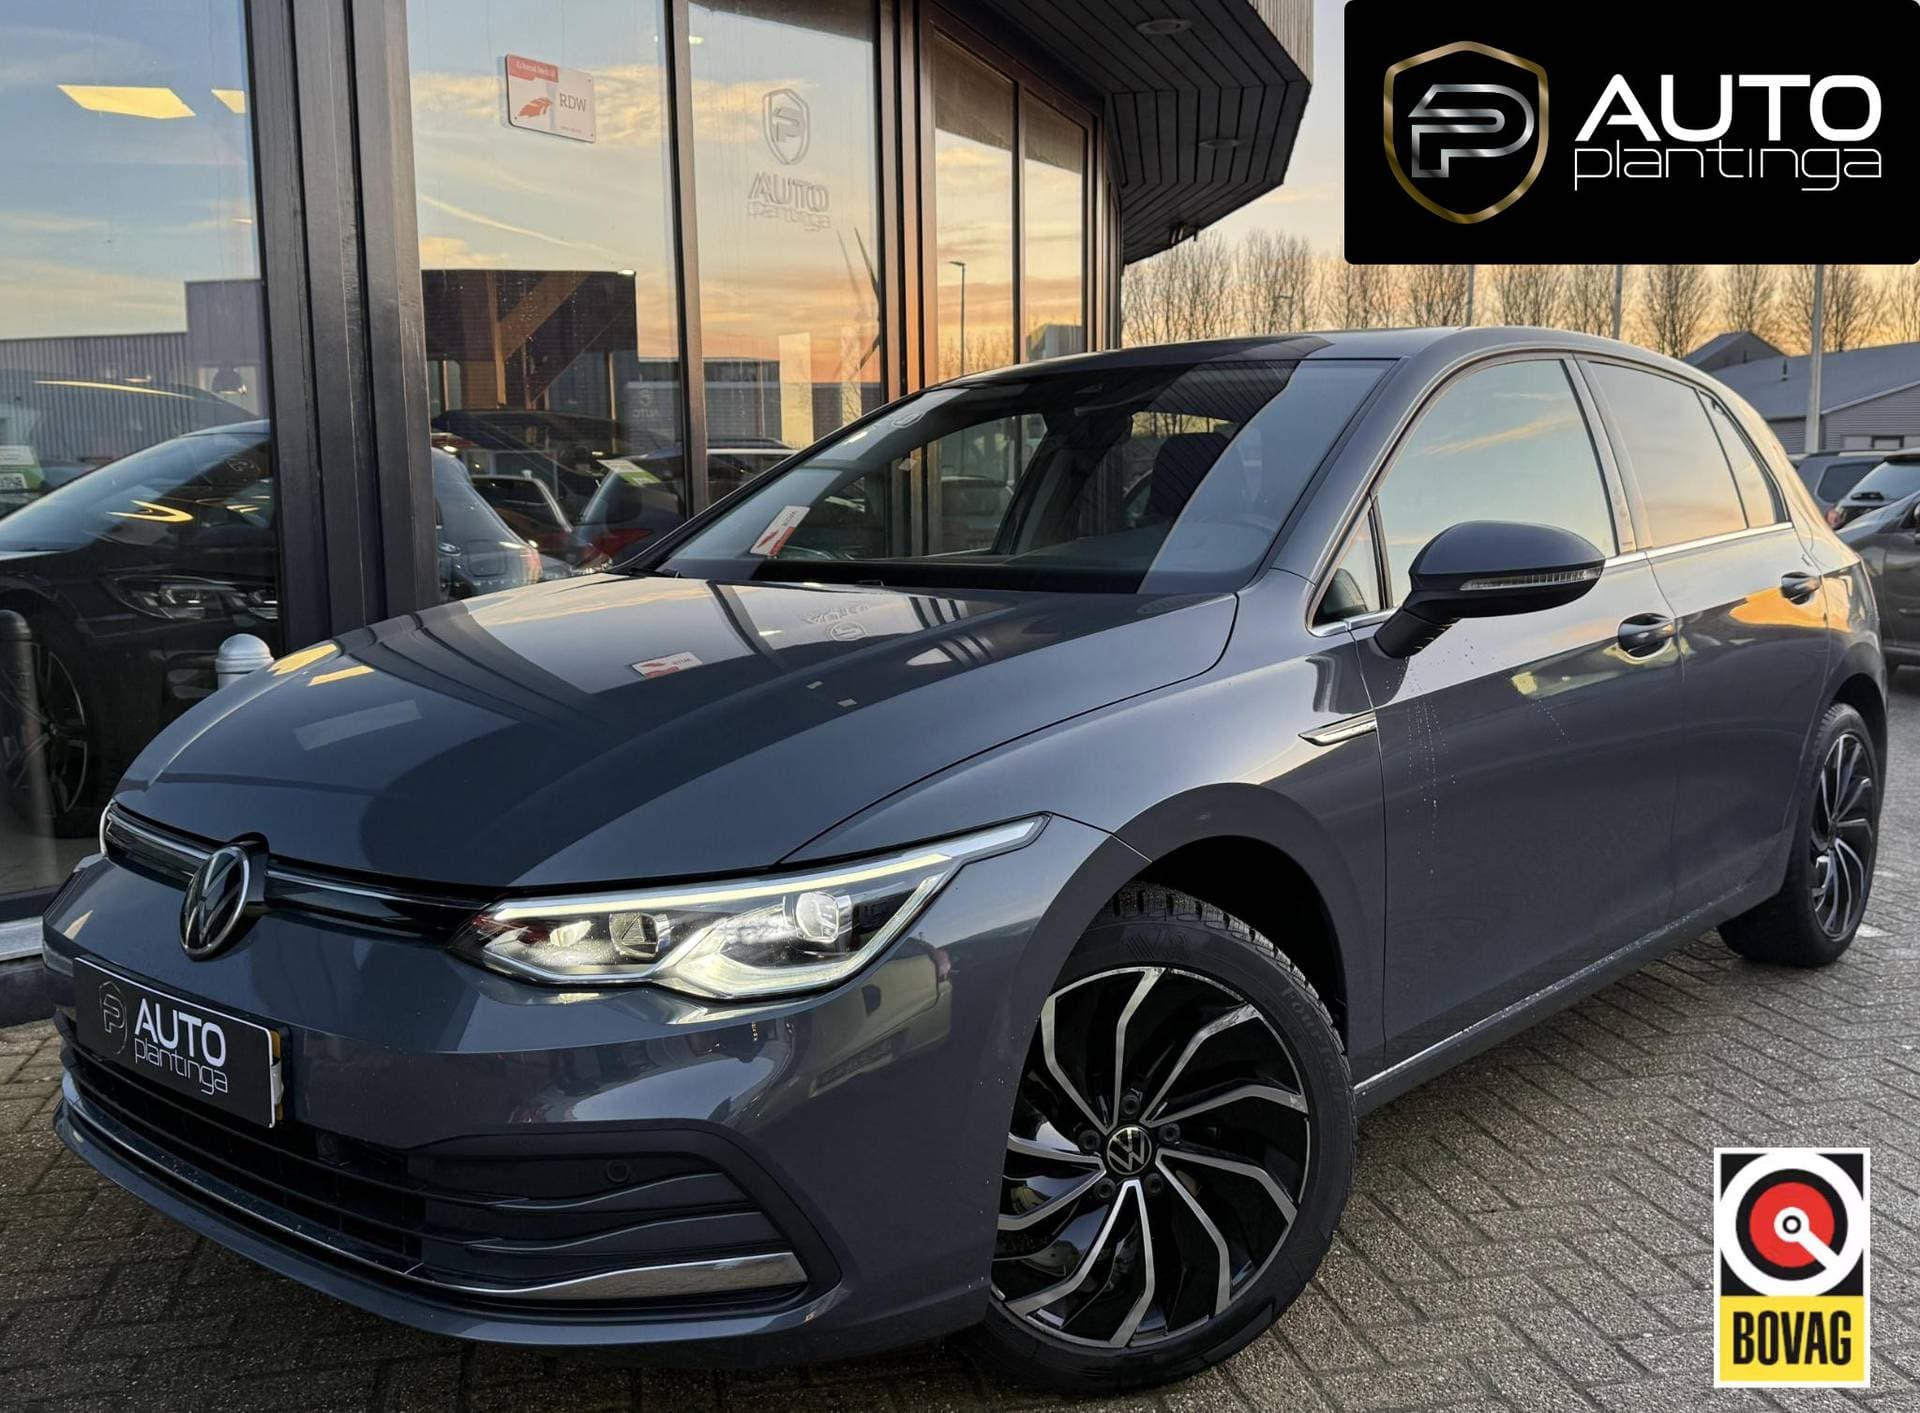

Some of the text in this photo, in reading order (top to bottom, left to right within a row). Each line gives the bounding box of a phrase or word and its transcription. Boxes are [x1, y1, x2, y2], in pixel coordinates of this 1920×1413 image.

[560, 93, 587, 112] RDW
[747, 172, 830, 213] AUTO
[134, 998, 227, 1067] AUTO
[134, 1037, 228, 1095] plantinga
